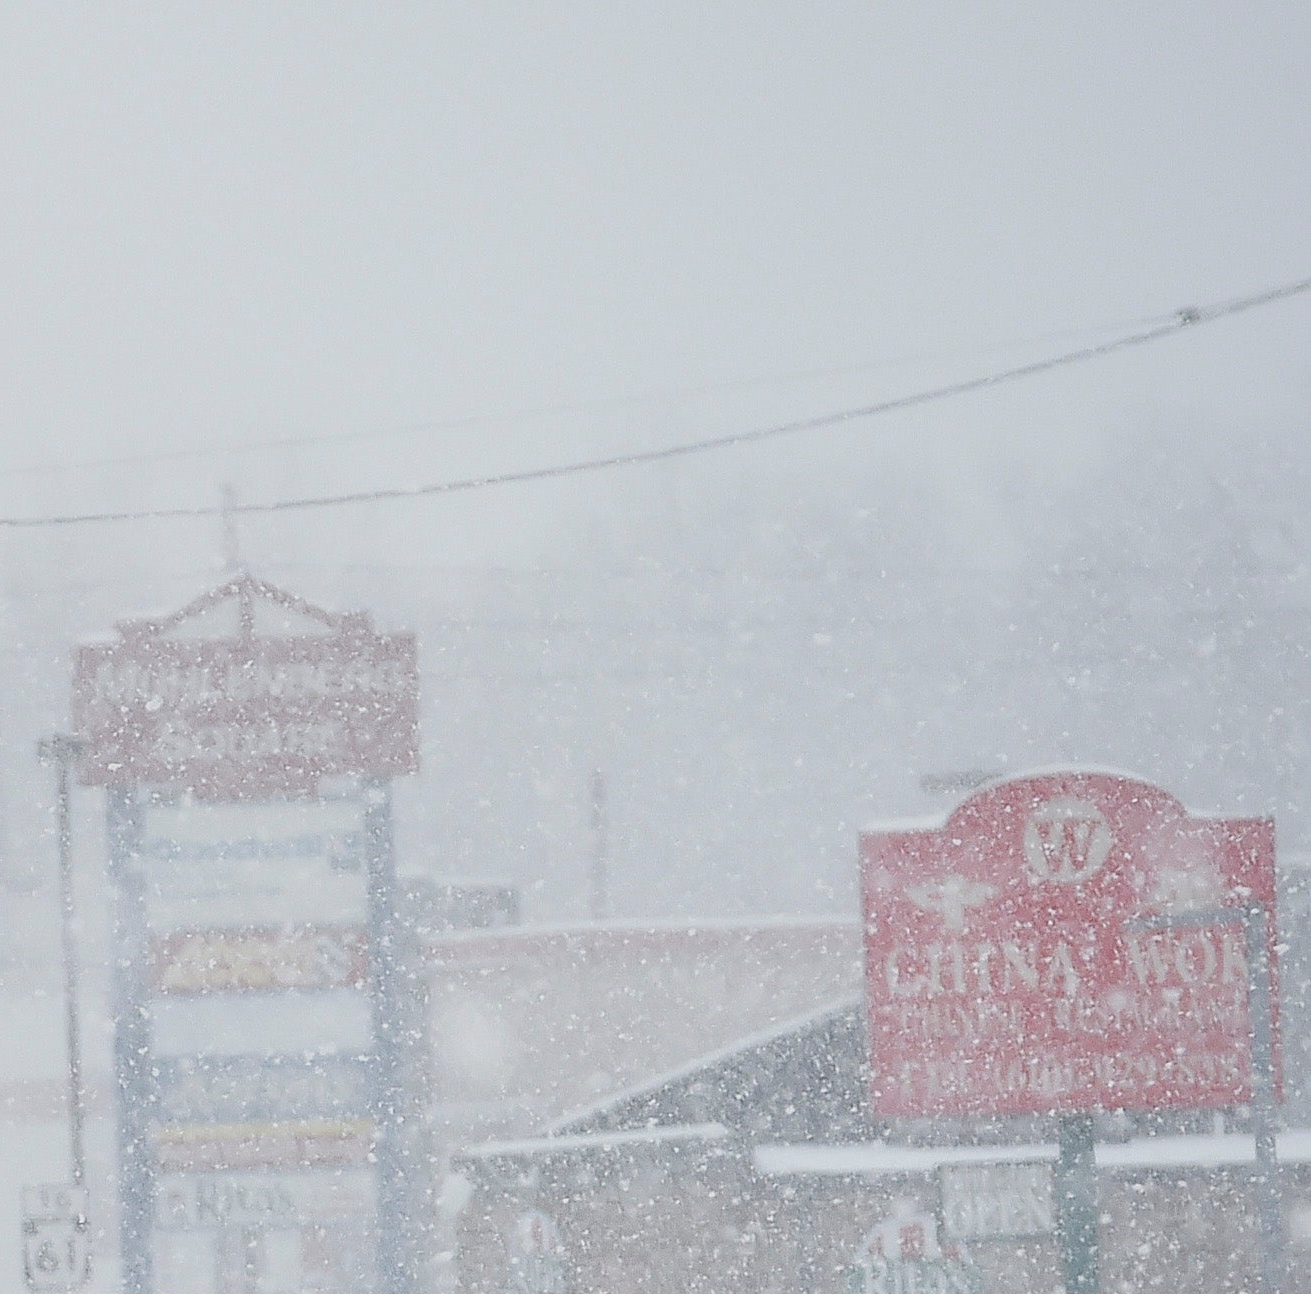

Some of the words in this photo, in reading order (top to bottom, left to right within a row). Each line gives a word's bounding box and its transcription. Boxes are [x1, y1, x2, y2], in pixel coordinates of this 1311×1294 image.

[885, 938, 1081, 996] CHINA
[944, 1192, 1056, 1238] OPEN
[36, 1239, 76, 1274] 61
